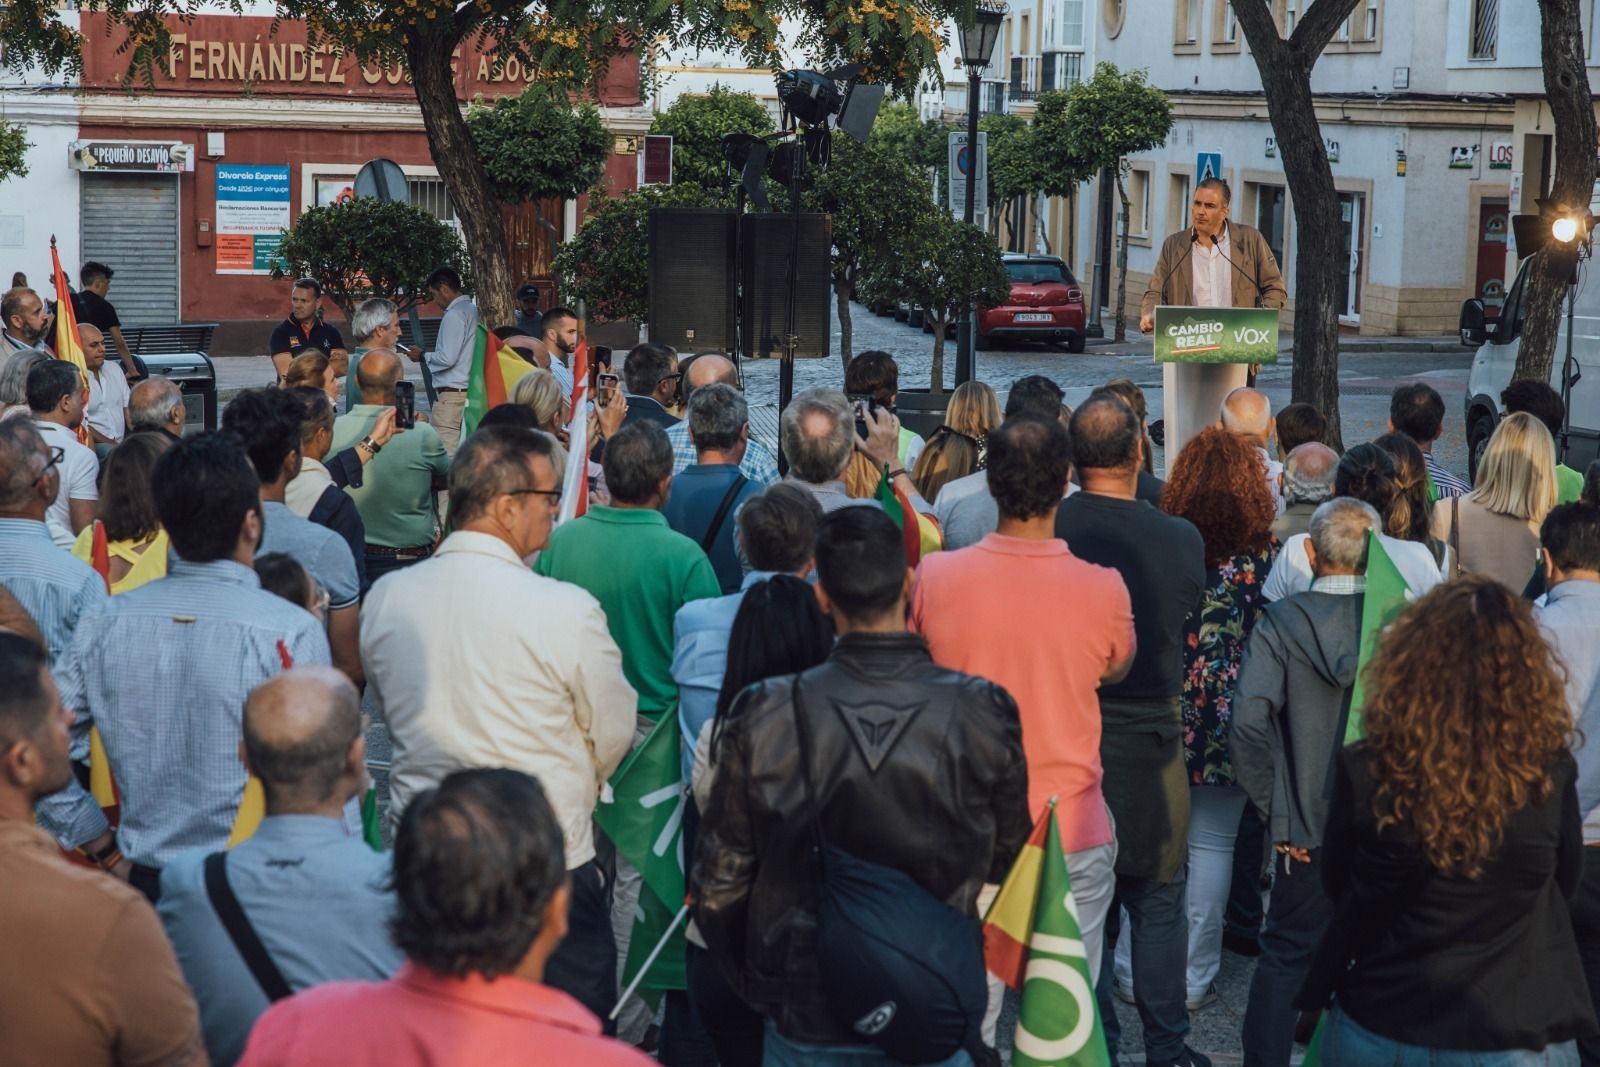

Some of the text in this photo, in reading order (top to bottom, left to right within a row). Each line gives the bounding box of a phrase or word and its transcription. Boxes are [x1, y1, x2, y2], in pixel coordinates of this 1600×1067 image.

[169, 33, 345, 84] FERNÁNDEZ
[99, 145, 135, 163] PEQUEÑO
[137, 145, 169, 163] DESAVÍO
[218, 171, 288, 181] Divorcio Express
[1176, 334, 1216, 348] REAL
[1234, 326, 1270, 345] VOX
